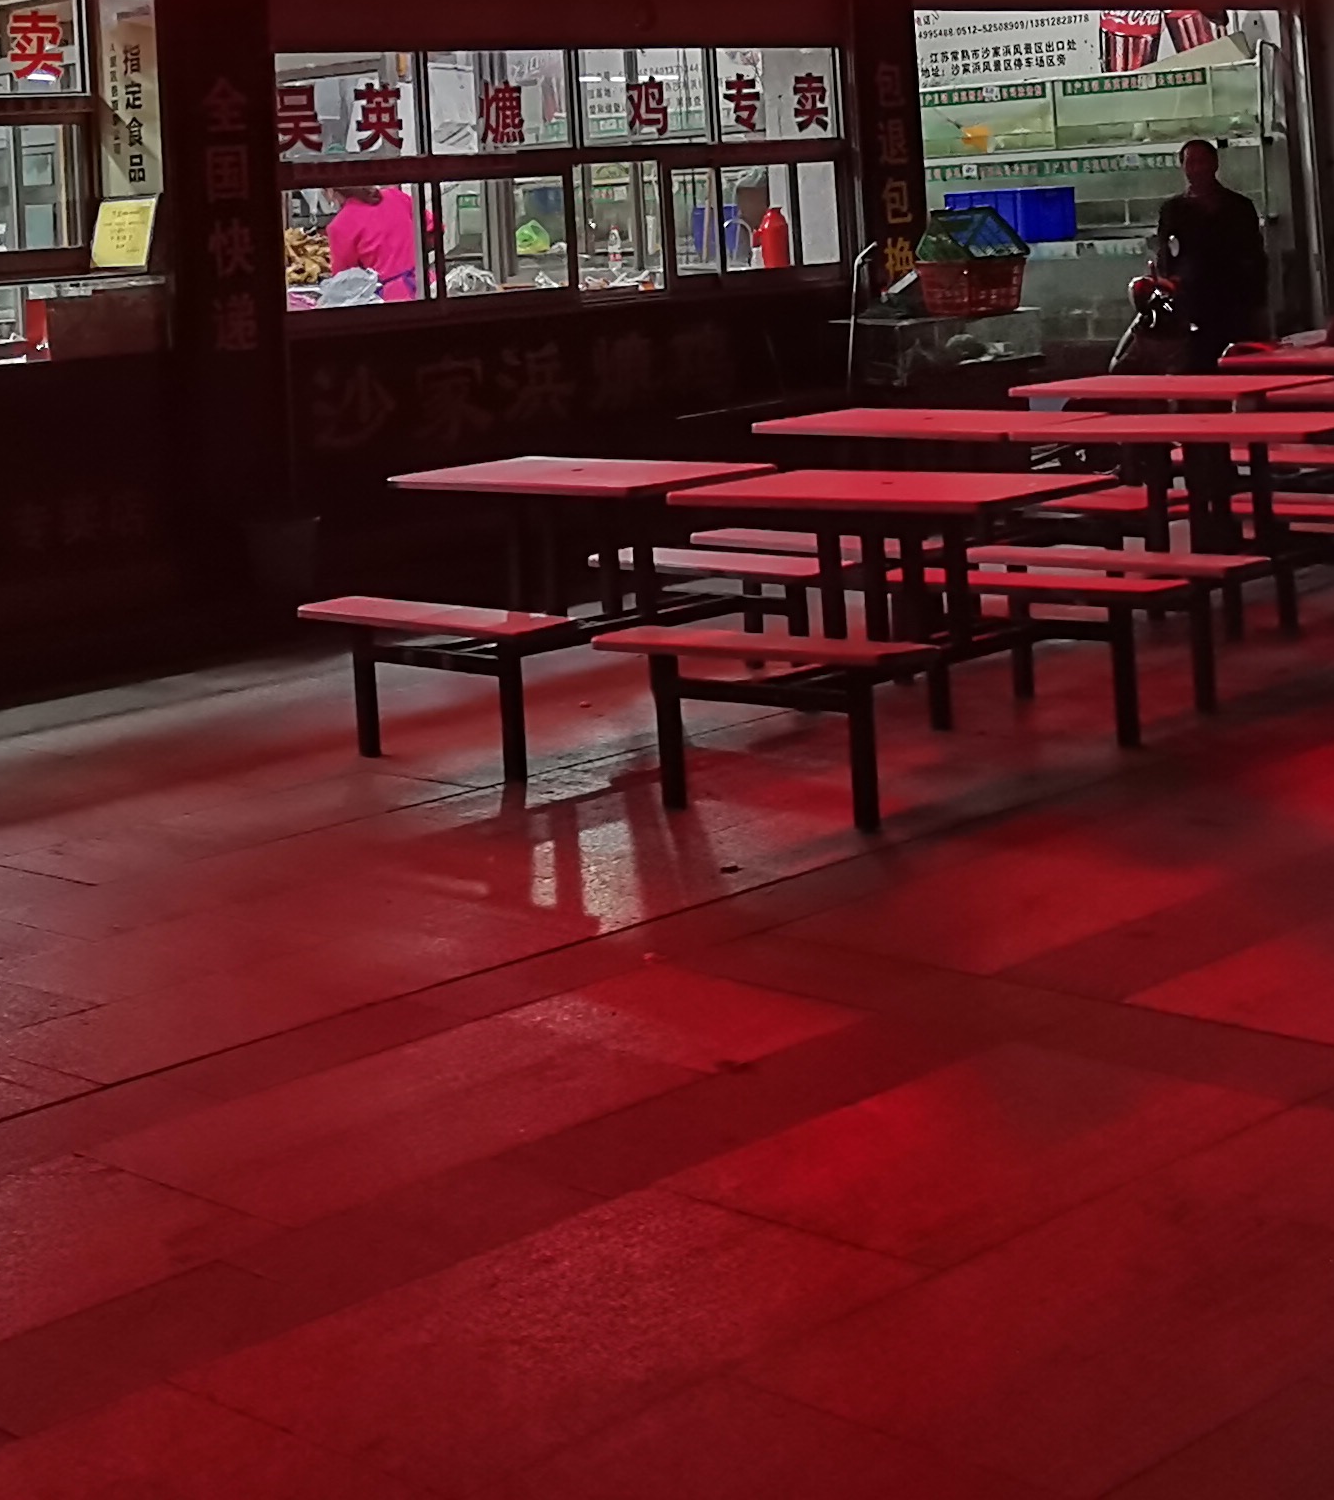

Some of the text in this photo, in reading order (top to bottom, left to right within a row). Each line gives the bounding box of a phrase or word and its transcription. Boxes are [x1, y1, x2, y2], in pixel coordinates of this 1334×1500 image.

[123, 44, 146, 183] 指定食品
[200, 77, 260, 351] 全国快递
